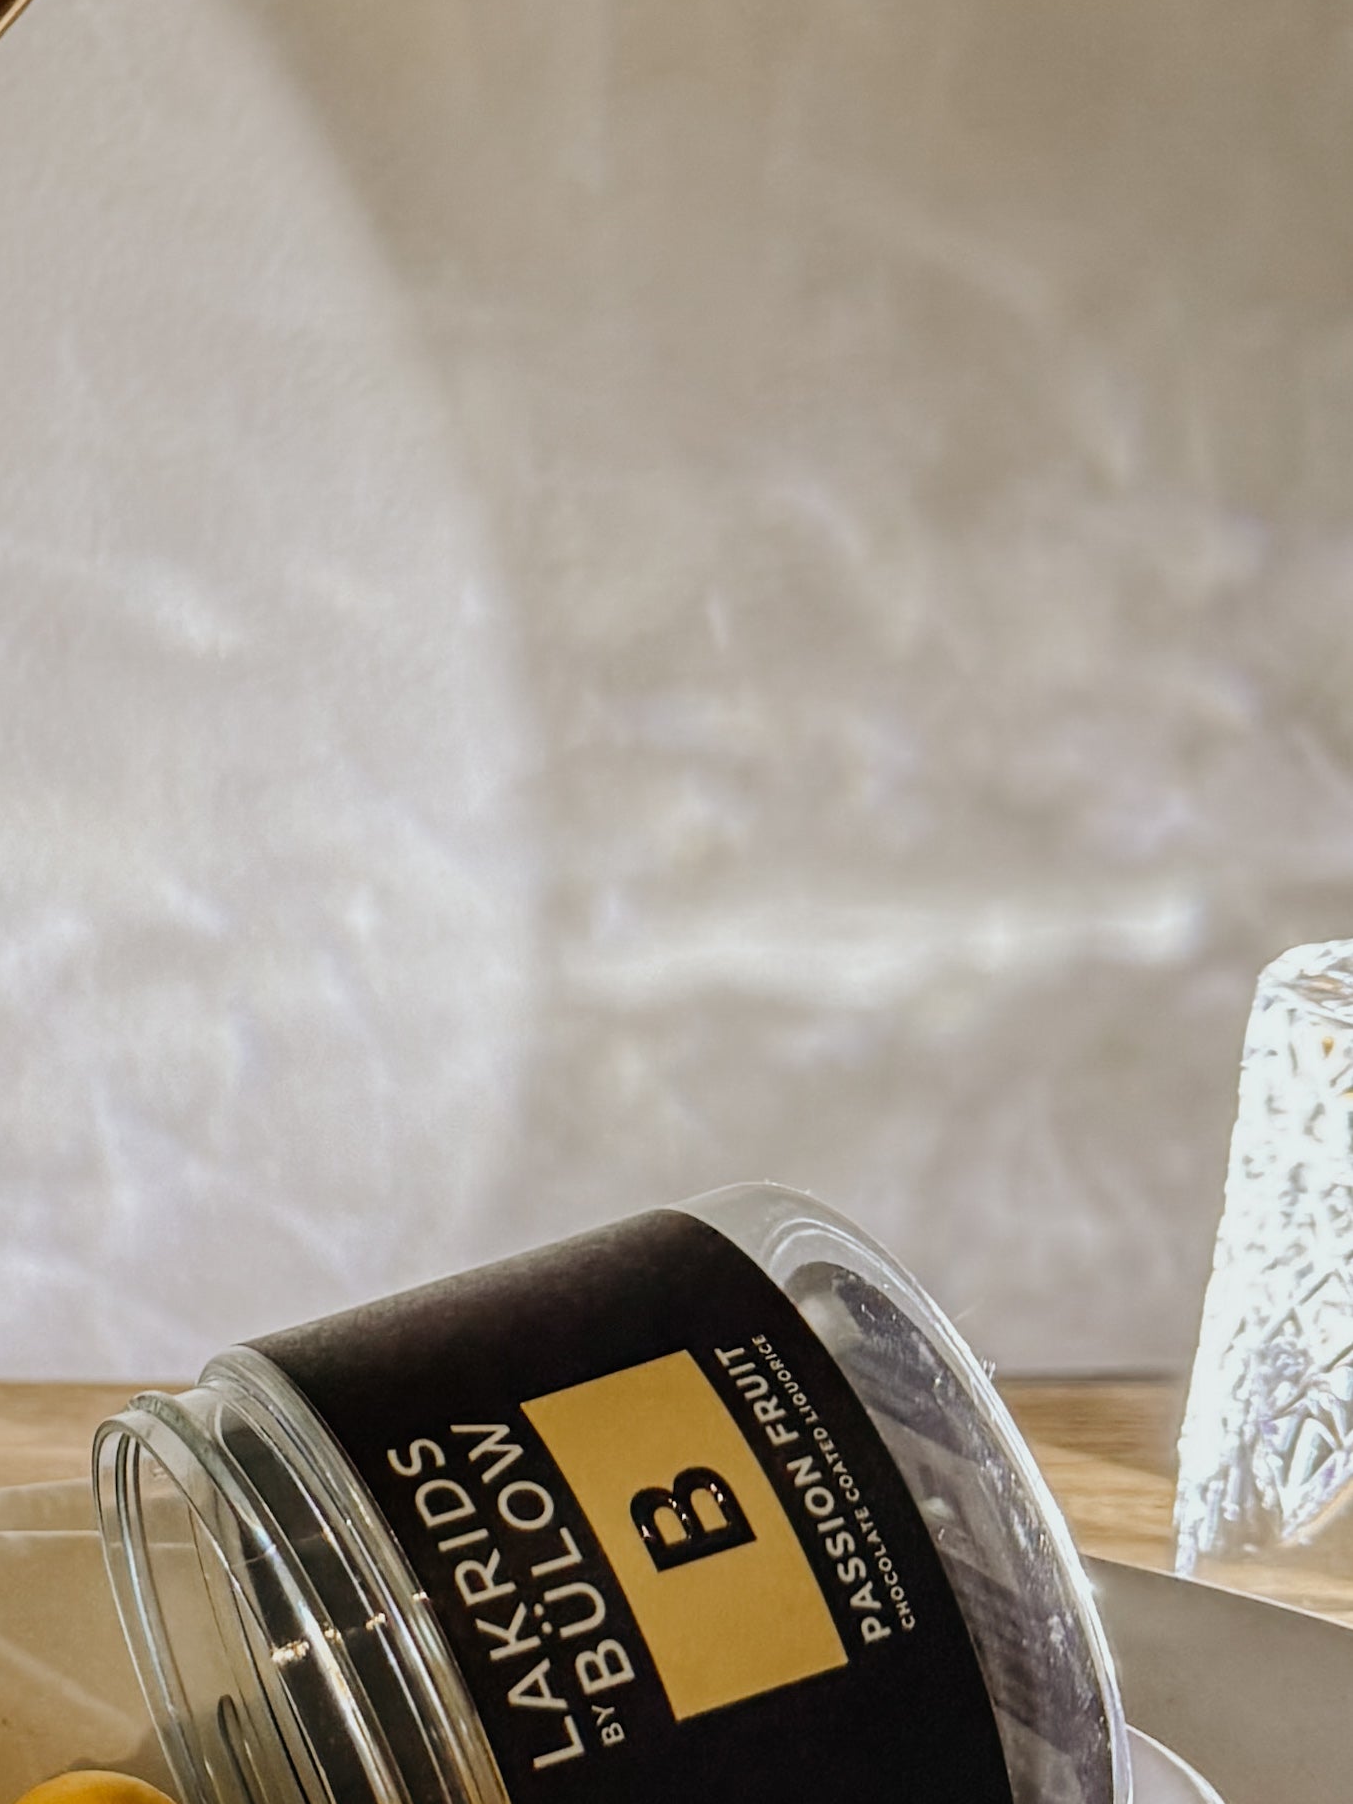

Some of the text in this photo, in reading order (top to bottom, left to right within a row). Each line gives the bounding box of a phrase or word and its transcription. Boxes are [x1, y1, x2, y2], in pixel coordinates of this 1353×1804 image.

[387, 1437, 586, 1770] LAKRIDS
[449, 1423, 636, 1747] BY BÜLOW
[630, 1464, 758, 1572] B
[714, 1346, 893, 1645] PASSION FRUIT
[751, 1333, 916, 1632] CHOCOLATE COATED LIQUORICE
